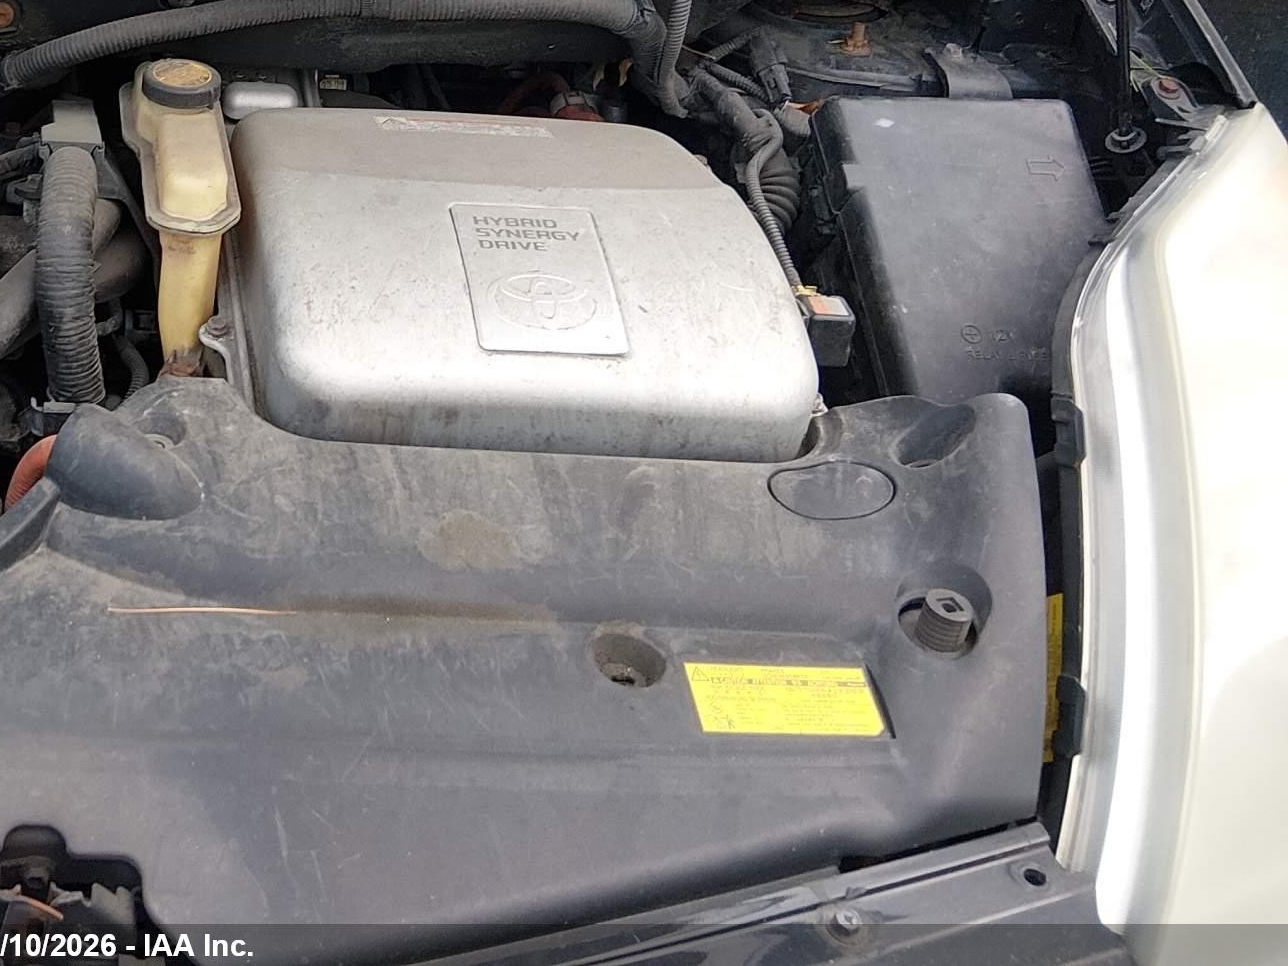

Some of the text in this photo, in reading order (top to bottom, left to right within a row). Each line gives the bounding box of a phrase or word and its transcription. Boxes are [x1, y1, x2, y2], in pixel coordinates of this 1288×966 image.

[473, 216, 557, 228] HYBRID
[475, 228, 579, 241] SYNERGY
[478, 240, 547, 251] DRIVE
